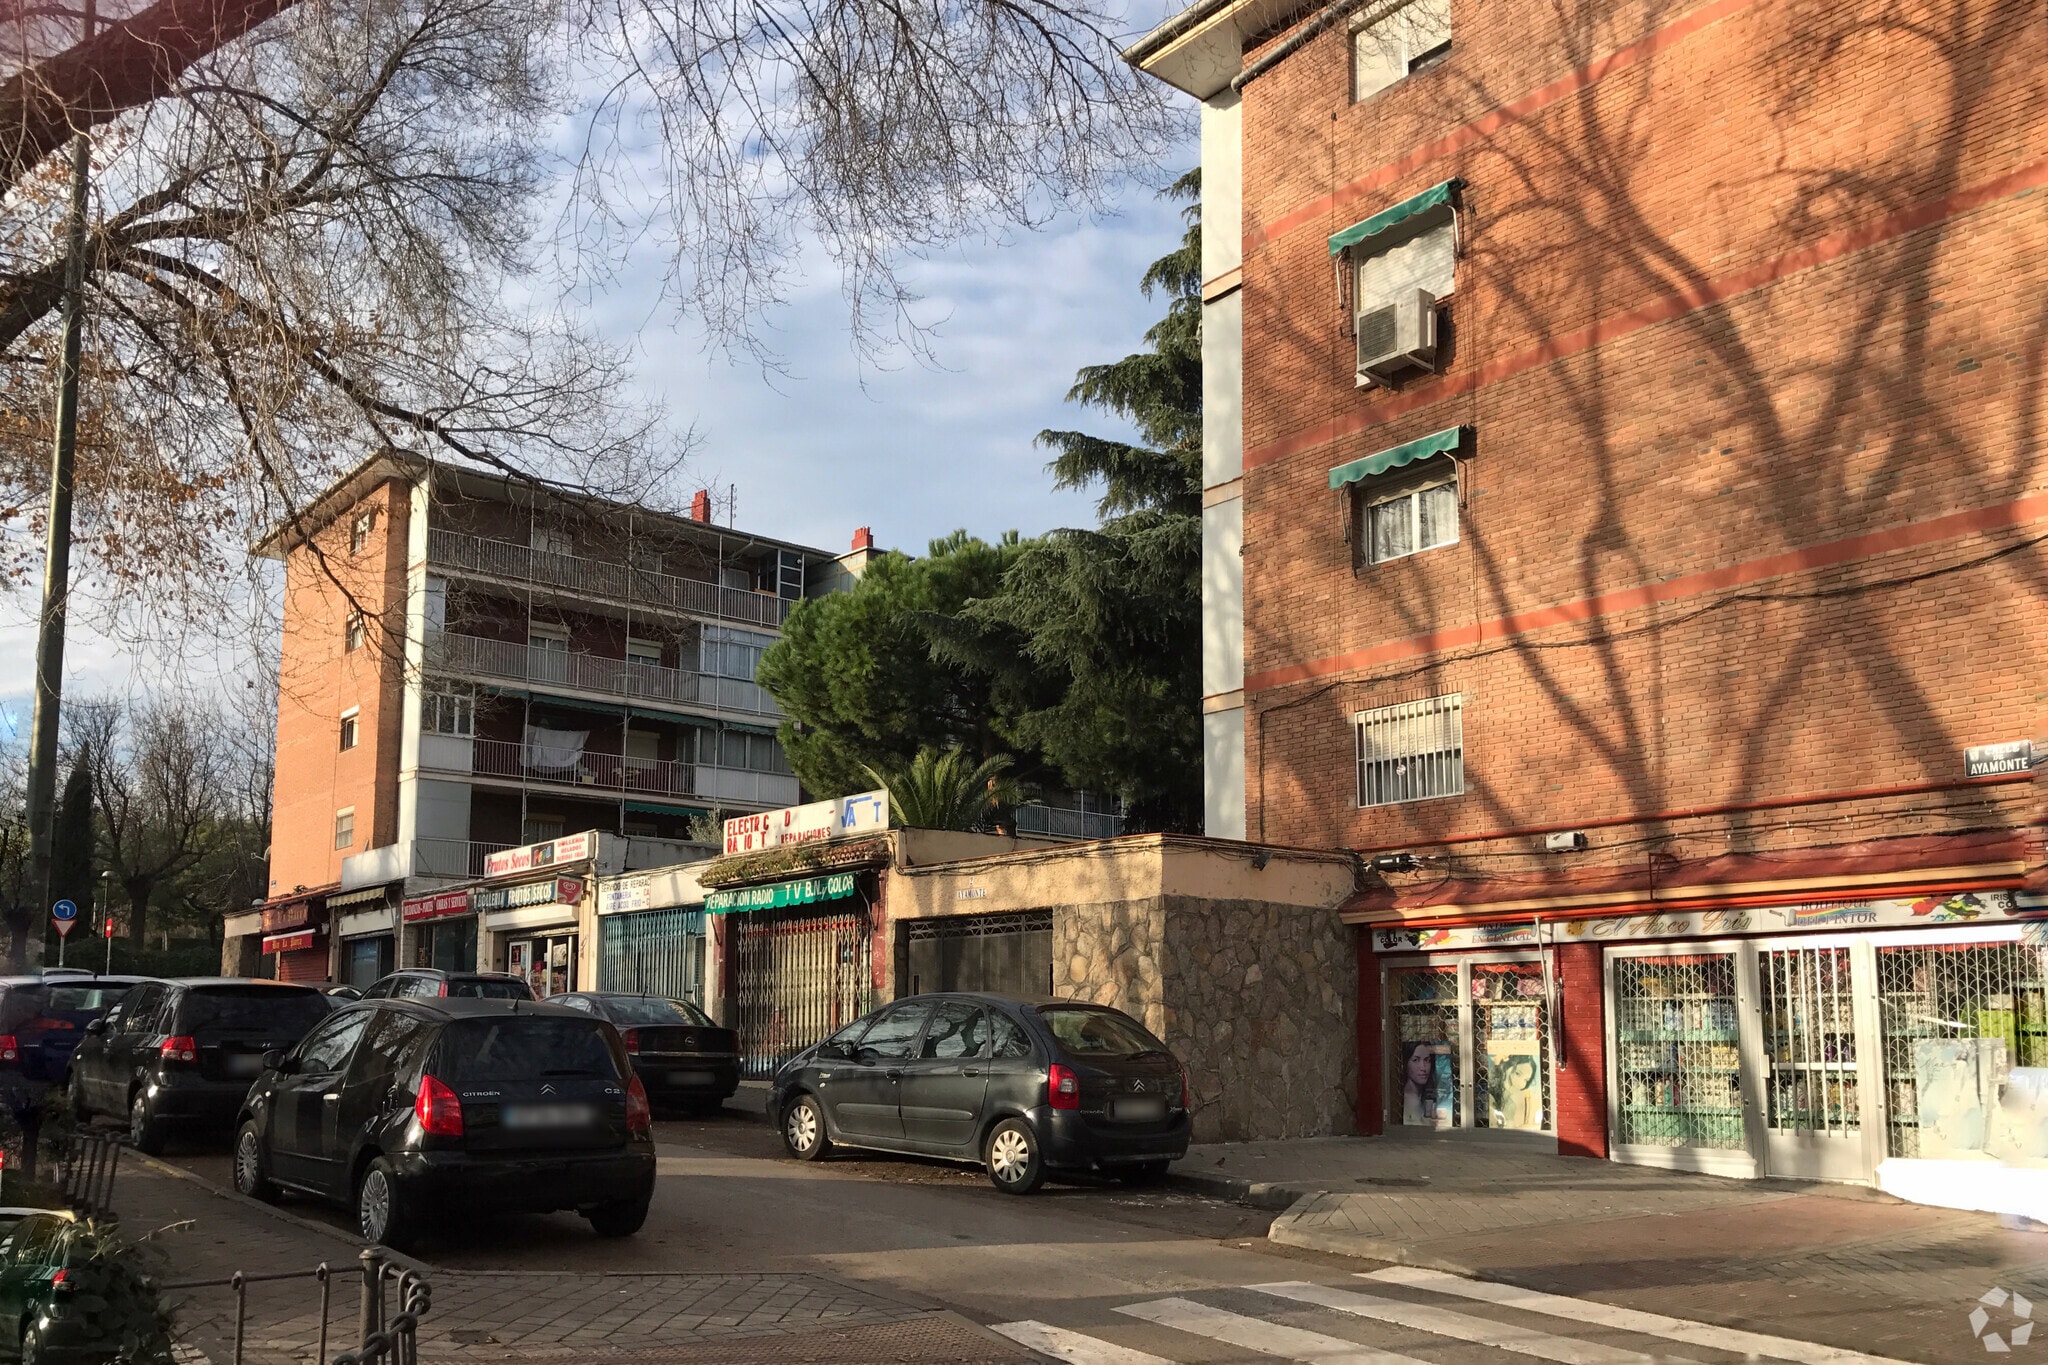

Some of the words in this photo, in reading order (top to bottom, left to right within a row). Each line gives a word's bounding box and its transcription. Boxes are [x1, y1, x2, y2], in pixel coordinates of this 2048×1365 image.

[1970, 757, 2029, 775] AYAMONTE
[780, 826, 831, 844] REPARACIONES
[486, 857, 509, 874] Frutos
[510, 853, 531, 869] Secos
[508, 887, 531, 905] FRUTOS
[532, 883, 552, 900] SECOS
[751, 888, 774, 904] RADIO
[828, 875, 855, 894] COLOR
[957, 888, 986, 899] AYAMONTE
[1629, 908, 1690, 936] Arco
[1702, 907, 1753, 931] Iris
[462, 1089, 500, 1097] CITROËN
